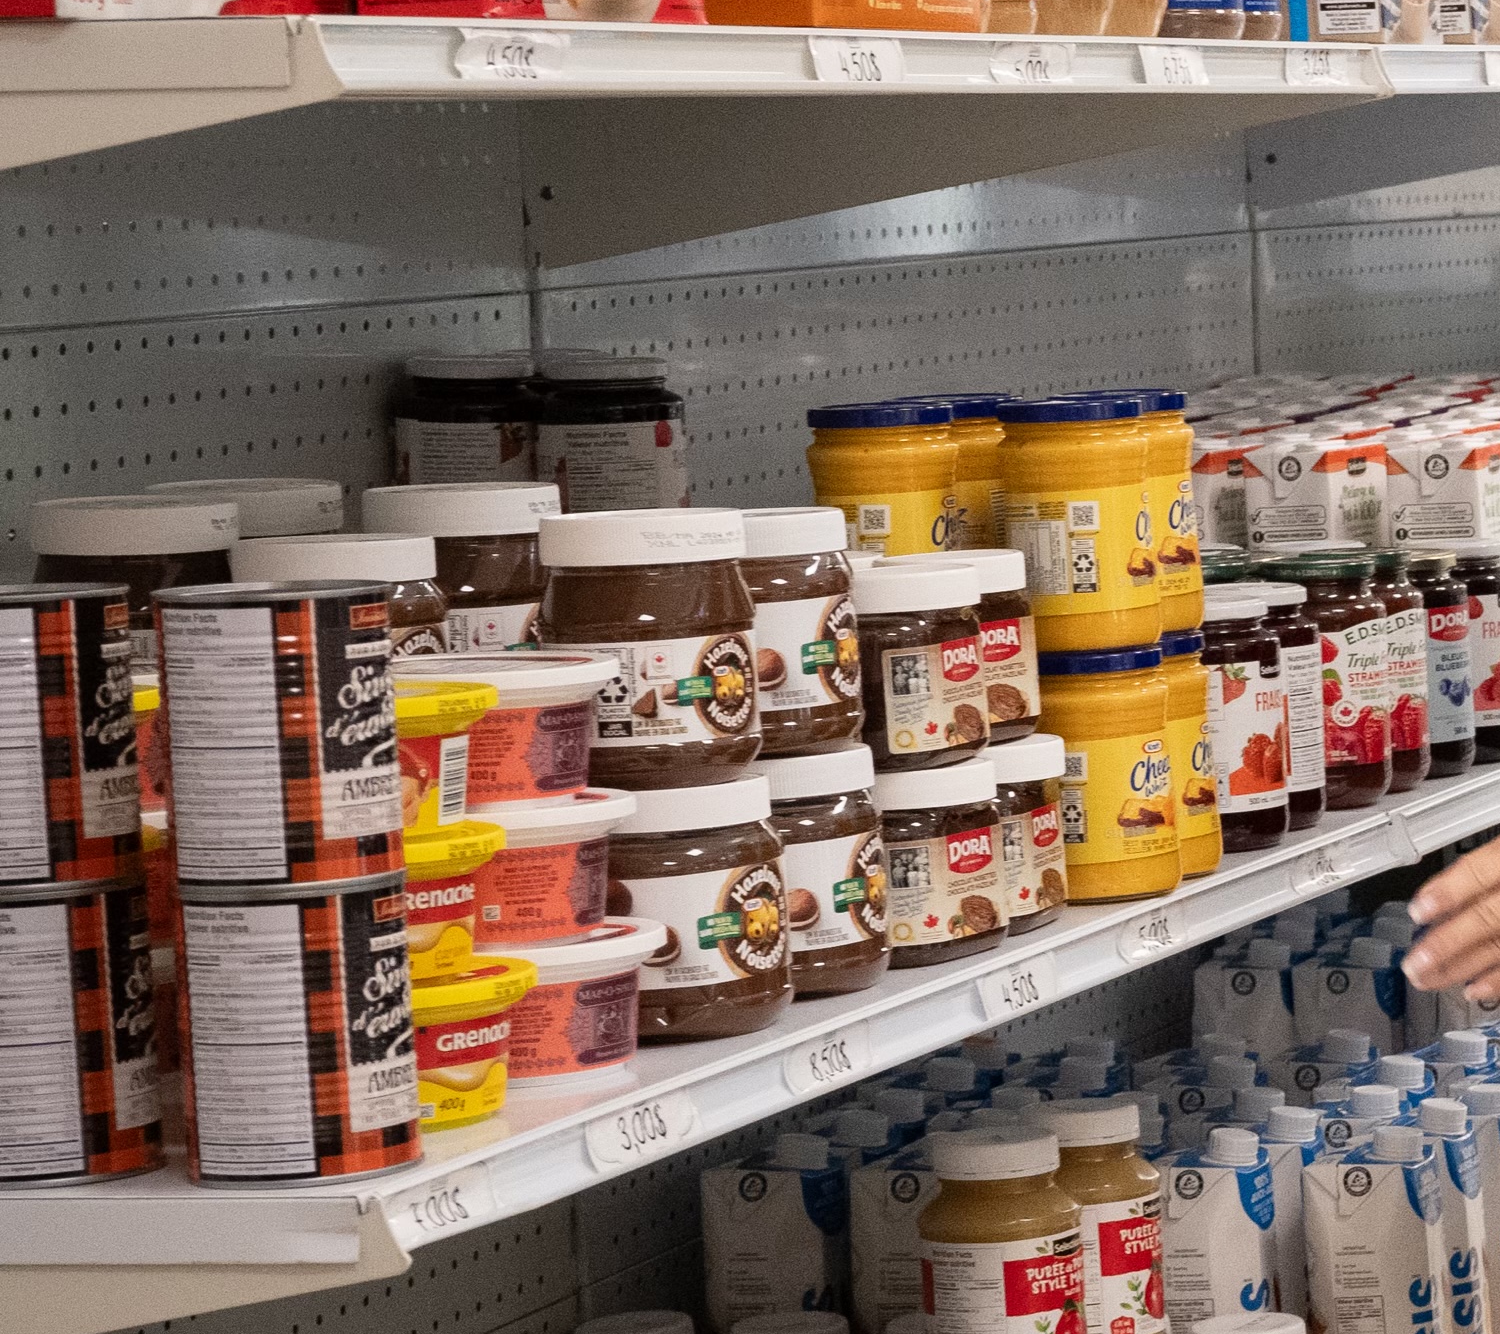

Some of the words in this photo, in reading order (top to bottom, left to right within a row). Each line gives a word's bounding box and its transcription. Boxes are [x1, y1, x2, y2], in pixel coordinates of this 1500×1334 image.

[942, 643, 979, 666] DORA
[1347, 652, 1379, 670] Triple
[1032, 810, 1058, 840] DORA
[948, 834, 991, 859] DORA
[1026, 1261, 1066, 1282] PURÉE
[1031, 1277, 1067, 1296] STYLE
